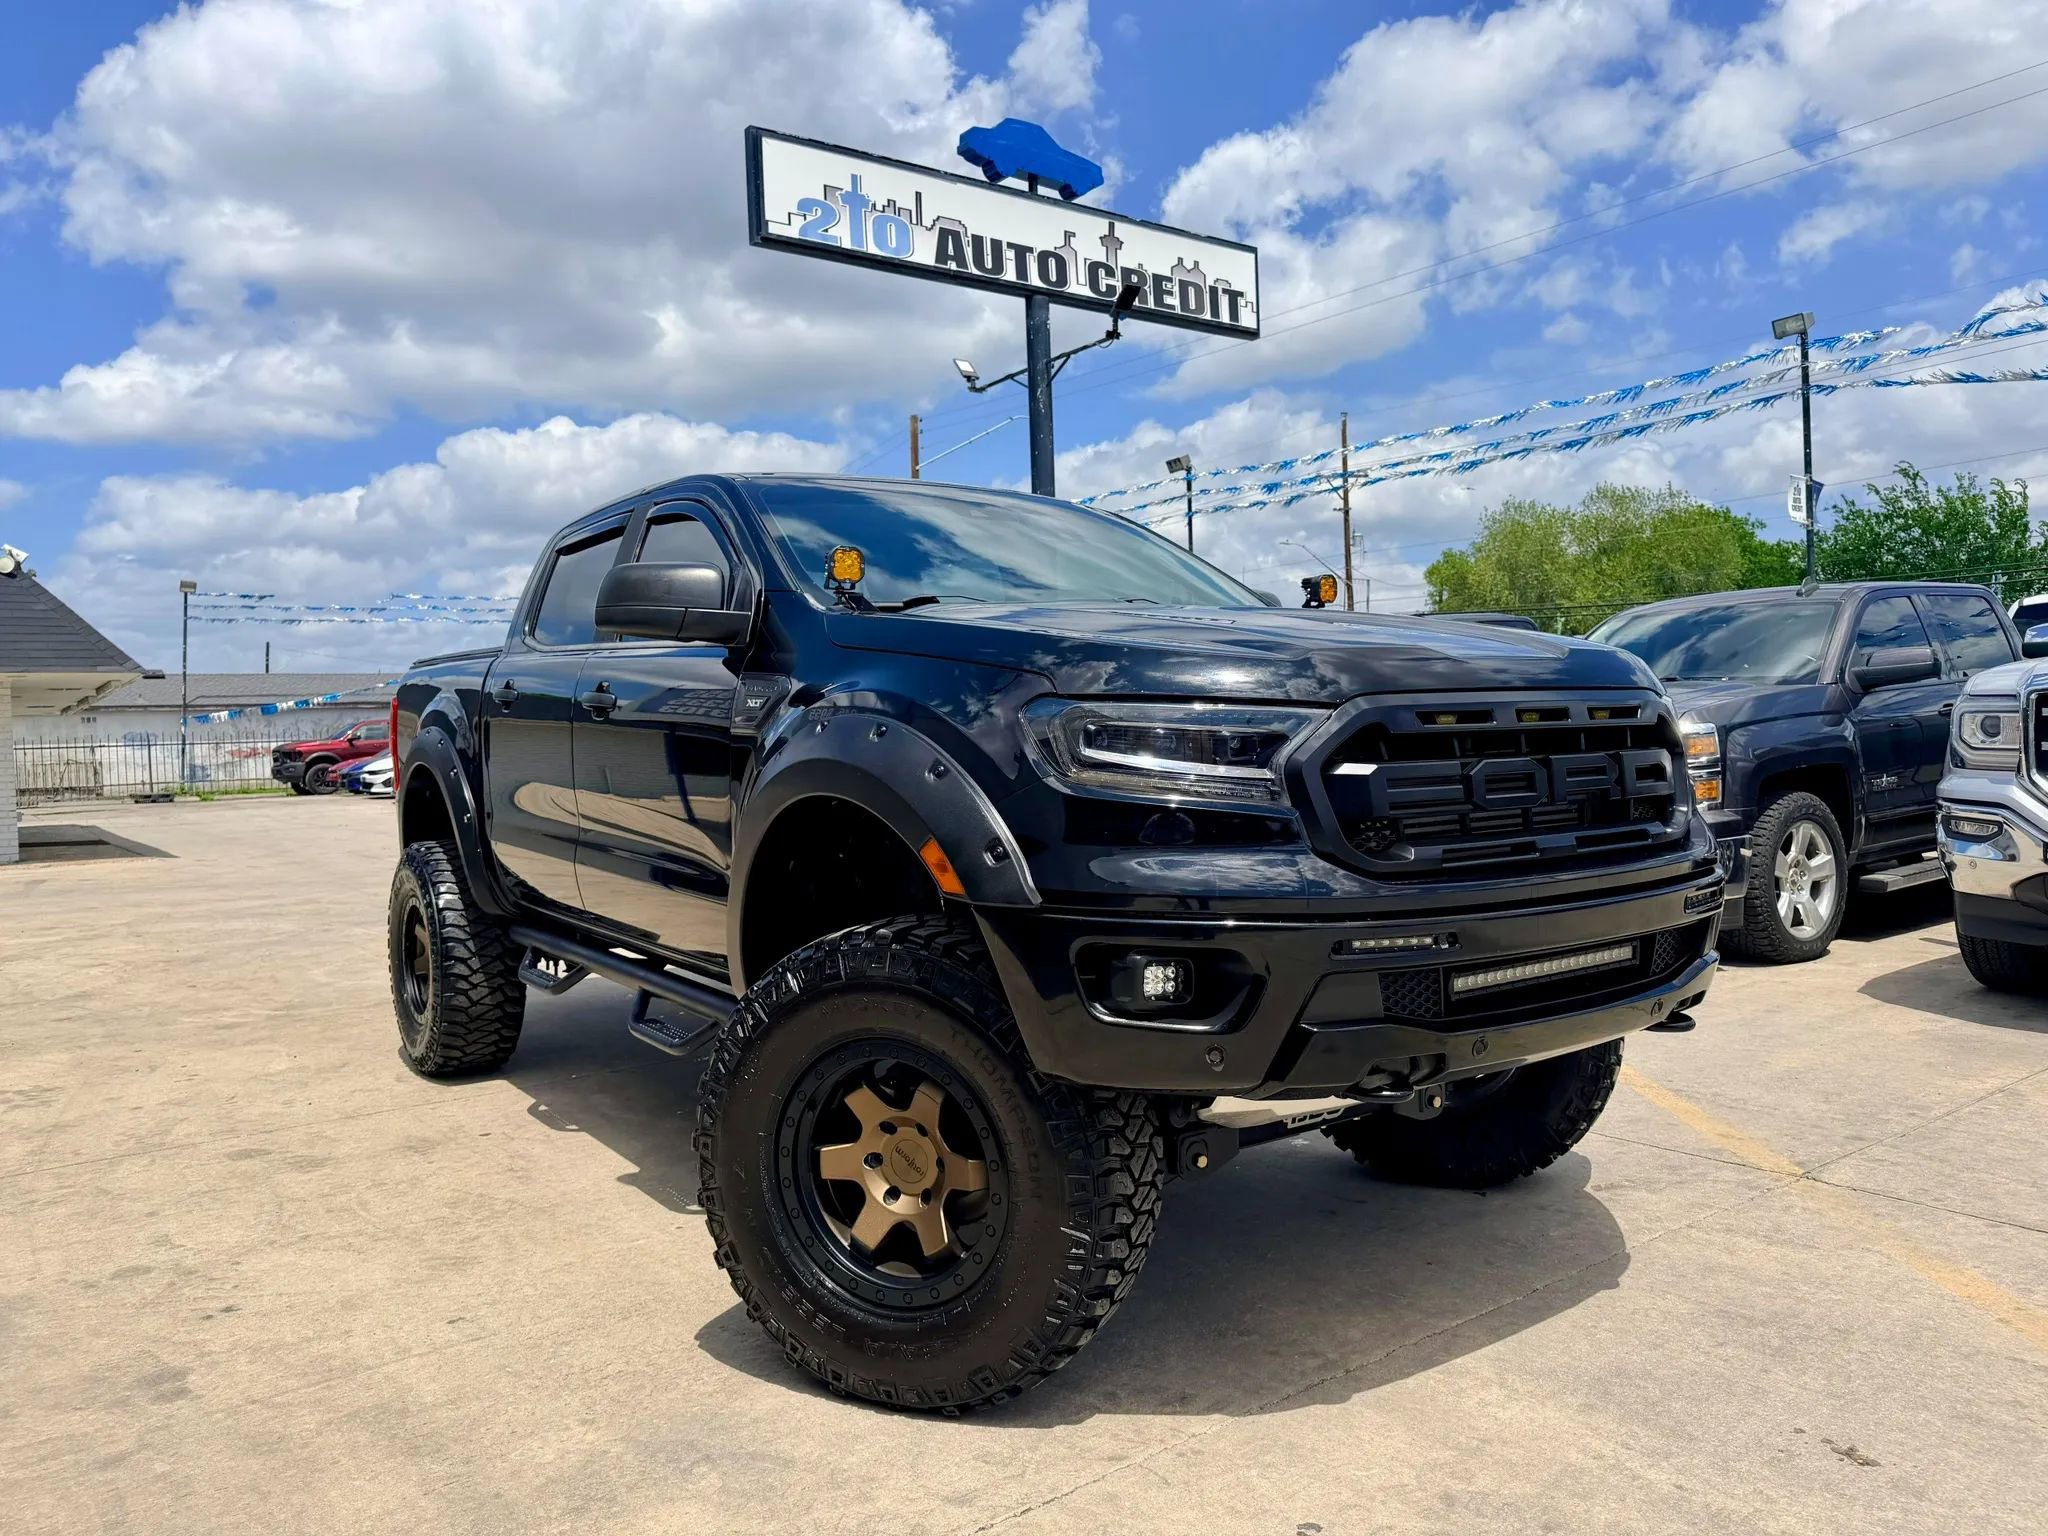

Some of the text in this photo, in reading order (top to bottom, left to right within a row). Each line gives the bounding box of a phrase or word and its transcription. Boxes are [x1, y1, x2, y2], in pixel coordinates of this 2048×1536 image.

[934, 226, 1069, 289] AUTO
[1087, 260, 1245, 324] CREDIT
[745, 699, 764, 707] XLT
[1338, 748, 1676, 817] FORD
[951, 1027, 1043, 1199] THOMPSON
[895, 1145, 925, 1177] rotiform
